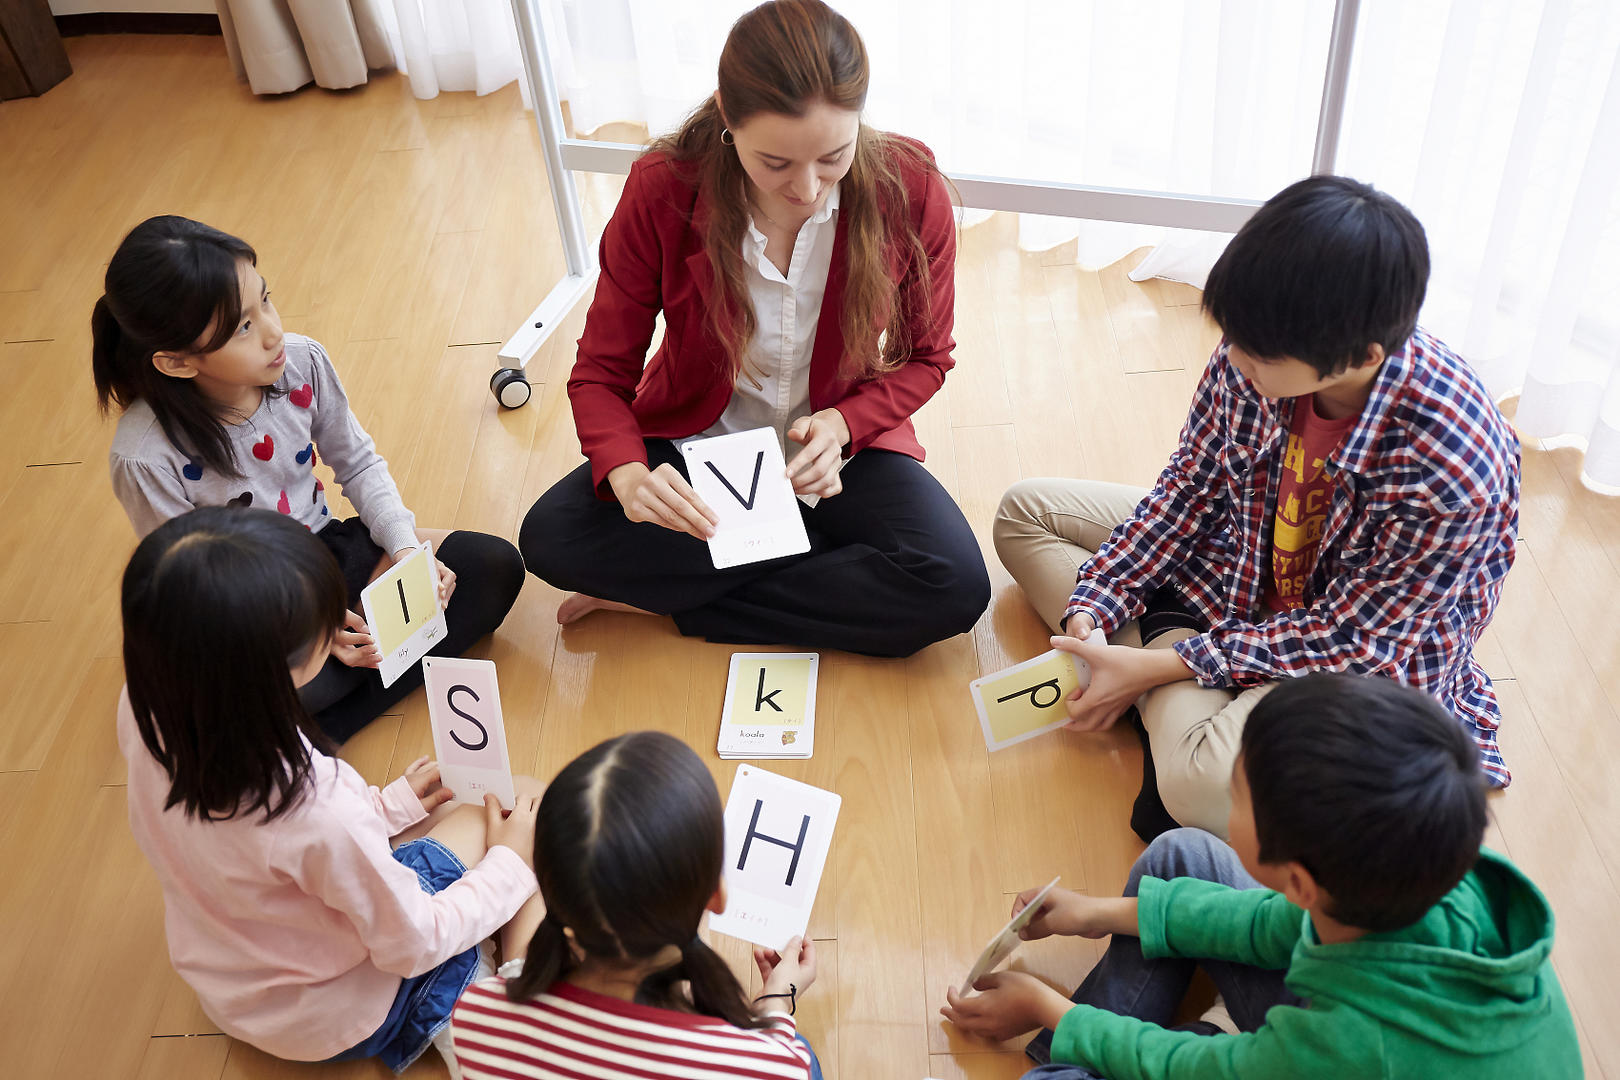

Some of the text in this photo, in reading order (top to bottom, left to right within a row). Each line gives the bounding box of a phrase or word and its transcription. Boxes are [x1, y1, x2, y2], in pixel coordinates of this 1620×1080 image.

[704, 451, 764, 511] V
[447, 684, 488, 751] S
[754, 667, 783, 712] k
[740, 730, 765, 738] koala
[736, 799, 811, 886] H
